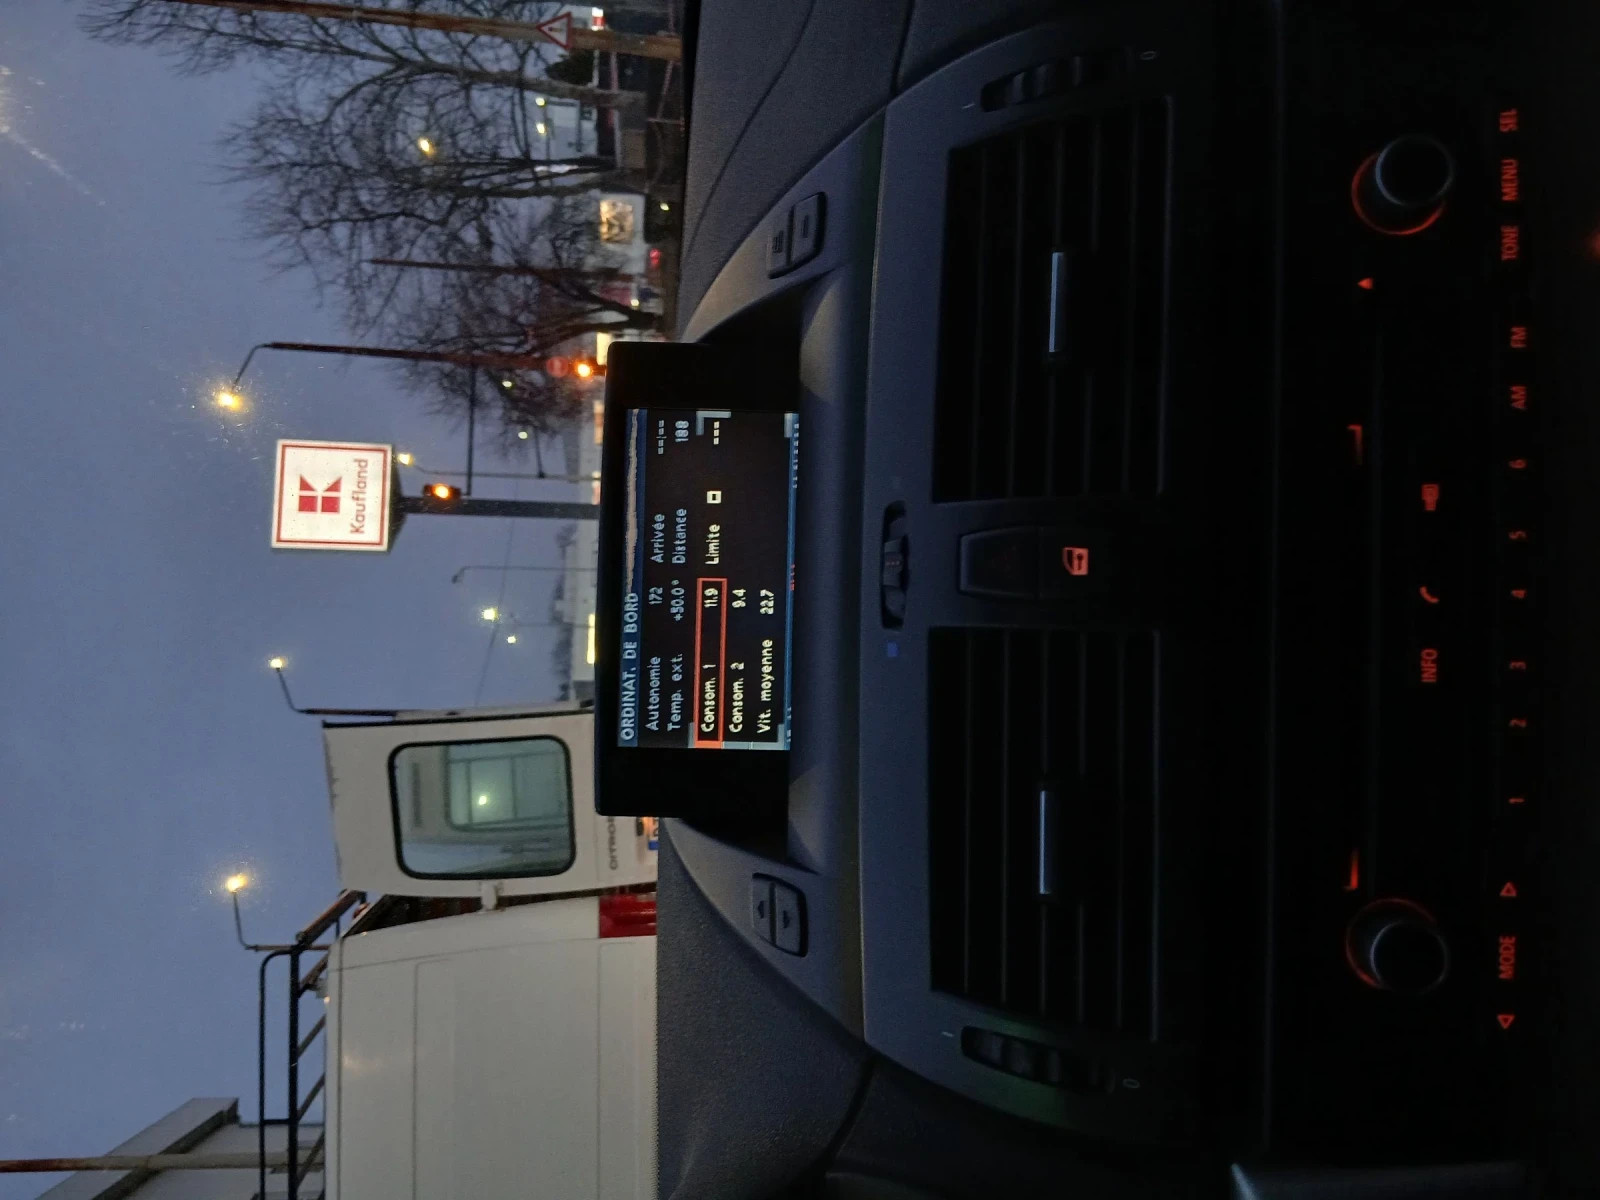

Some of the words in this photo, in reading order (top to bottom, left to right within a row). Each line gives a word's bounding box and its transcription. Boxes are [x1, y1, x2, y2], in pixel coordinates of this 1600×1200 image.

[1500, 109, 1518, 132] SEL
[1501, 159, 1519, 201] MENU
[1501, 226, 1520, 260] TONE
[1510, 327, 1527, 348] FM
[1510, 386, 1527, 409] AM
[1509, 460, 1527, 468] 6
[350, 458, 368, 534] Kaufland
[650, 514, 666, 563] Arrivée
[672, 509, 687, 563] Distance
[705, 525, 721, 564] Limite
[1509, 531, 1527, 539] 5
[649, 587, 664, 604] 172
[704, 588, 719, 607] 11.9
[732, 589, 747, 607] 9.4
[760, 589, 775, 614] 22.7
[1511, 590, 1527, 598] 4
[624, 592, 640, 633] BORD
[623, 642, 638, 659] DE
[1421, 649, 1438, 682] INFO
[670, 654, 683, 681] ext.
[761, 640, 775, 701] moyenne
[620, 667, 637, 740] ORDINAT.
[645, 657, 661, 730] Autonomie
[701, 678, 716, 732] Consom.
[729, 678, 744, 732] Consom.
[667, 690, 684, 731] Temp.
[757, 709, 772, 733] Vit.
[1509, 719, 1527, 728] 2
[1499, 936, 1517, 979] MODE
